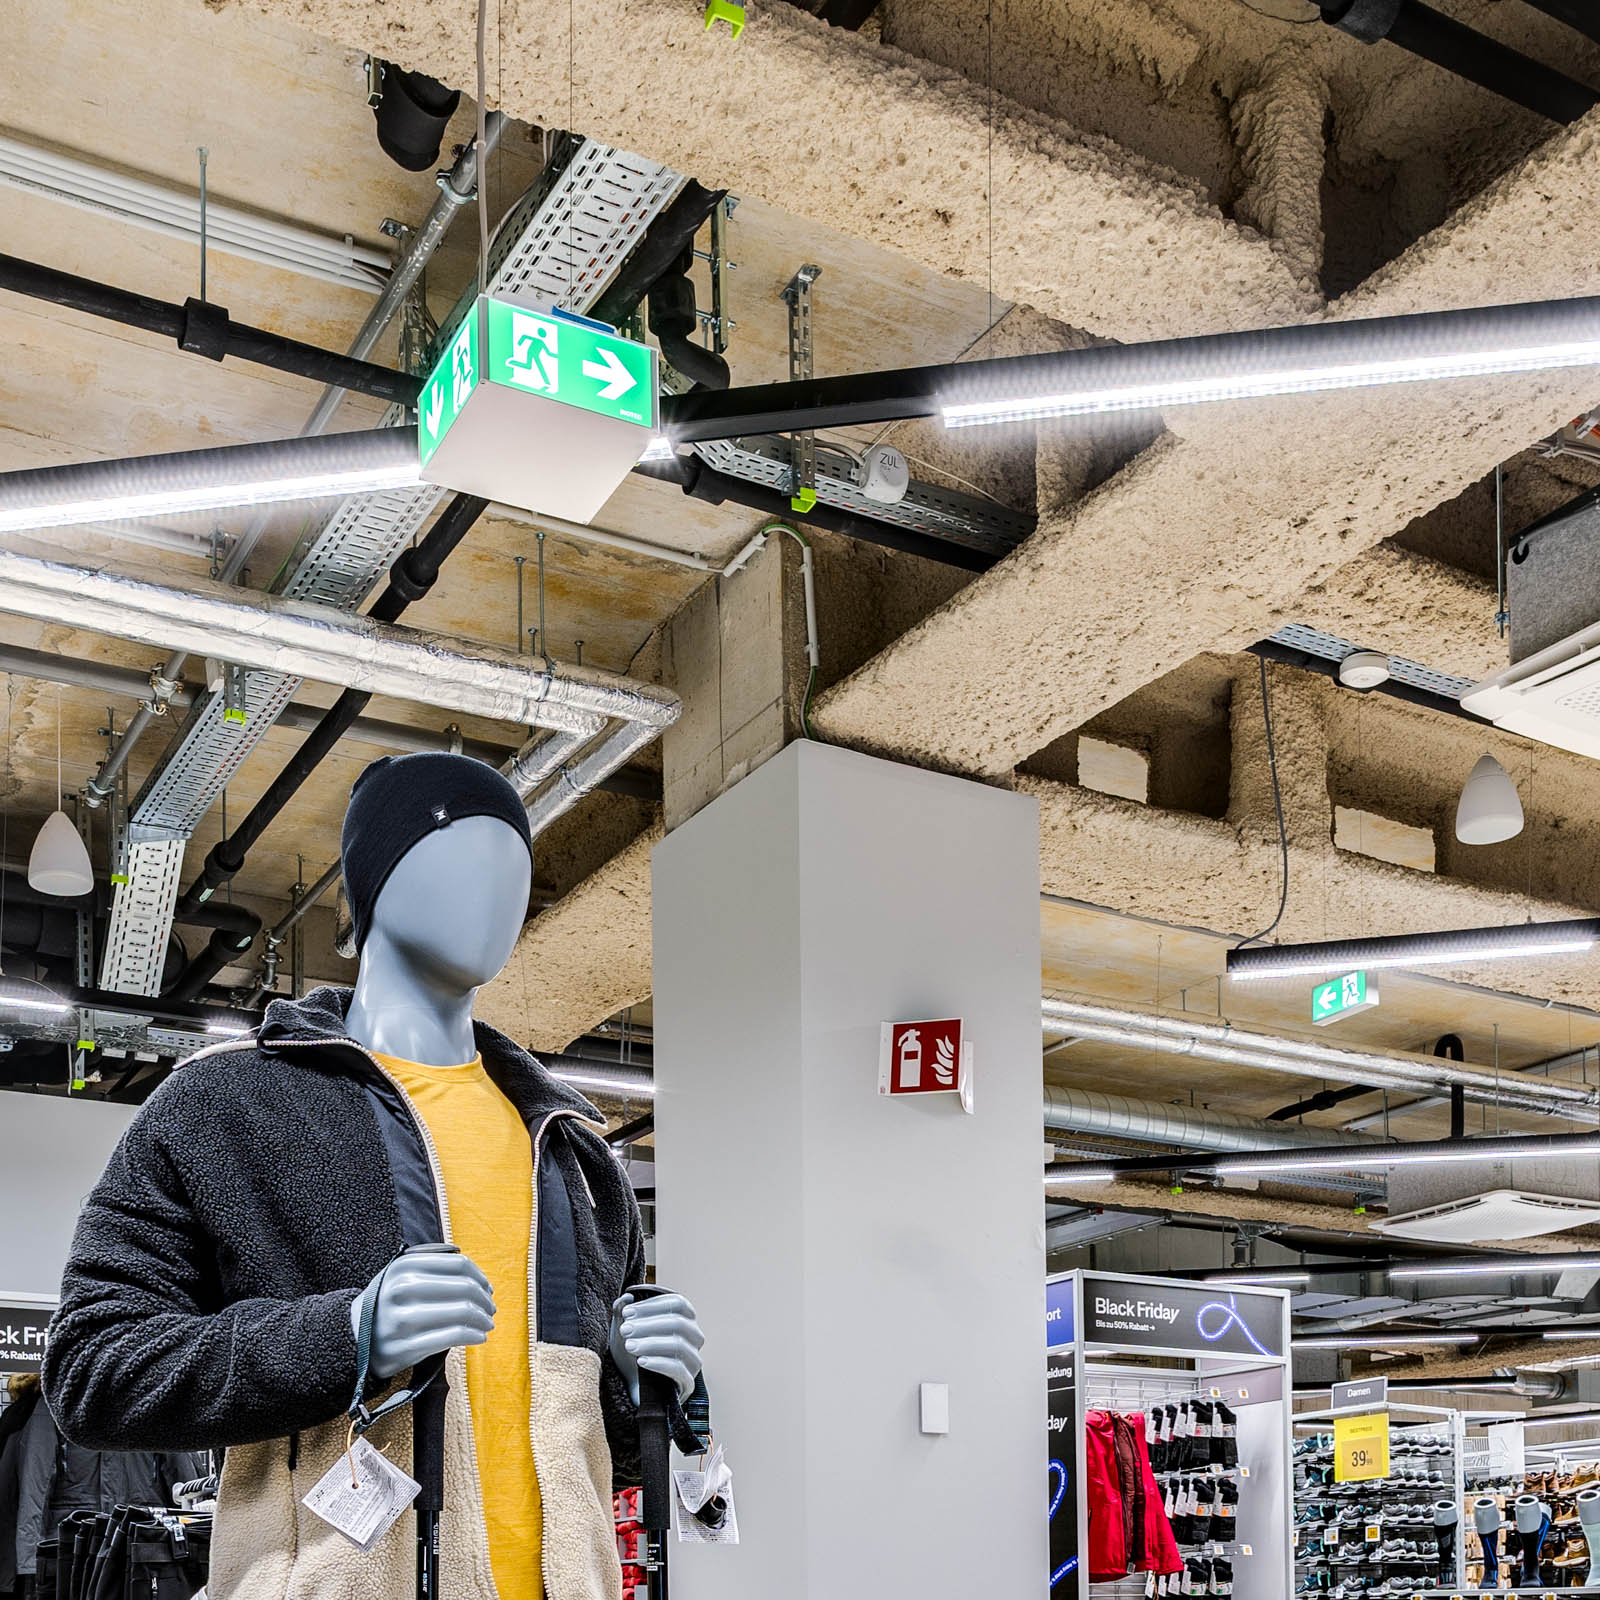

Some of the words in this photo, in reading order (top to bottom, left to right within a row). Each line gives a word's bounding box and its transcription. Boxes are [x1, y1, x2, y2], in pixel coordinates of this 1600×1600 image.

[1095, 1297, 1136, 1317] Black
[1137, 1301, 1180, 1324] Friday
[1114, 1321, 1129, 1330] 50%
[1129, 1322, 1150, 1332] Rabatt
[23, 1326, 49, 1346] Fri
[10, 1351, 42, 1361] Rabatt
[1047, 1366, 1072, 1378] eidung
[1347, 1387, 1371, 1398] Damen
[1351, 1450, 1366, 1468] 39
